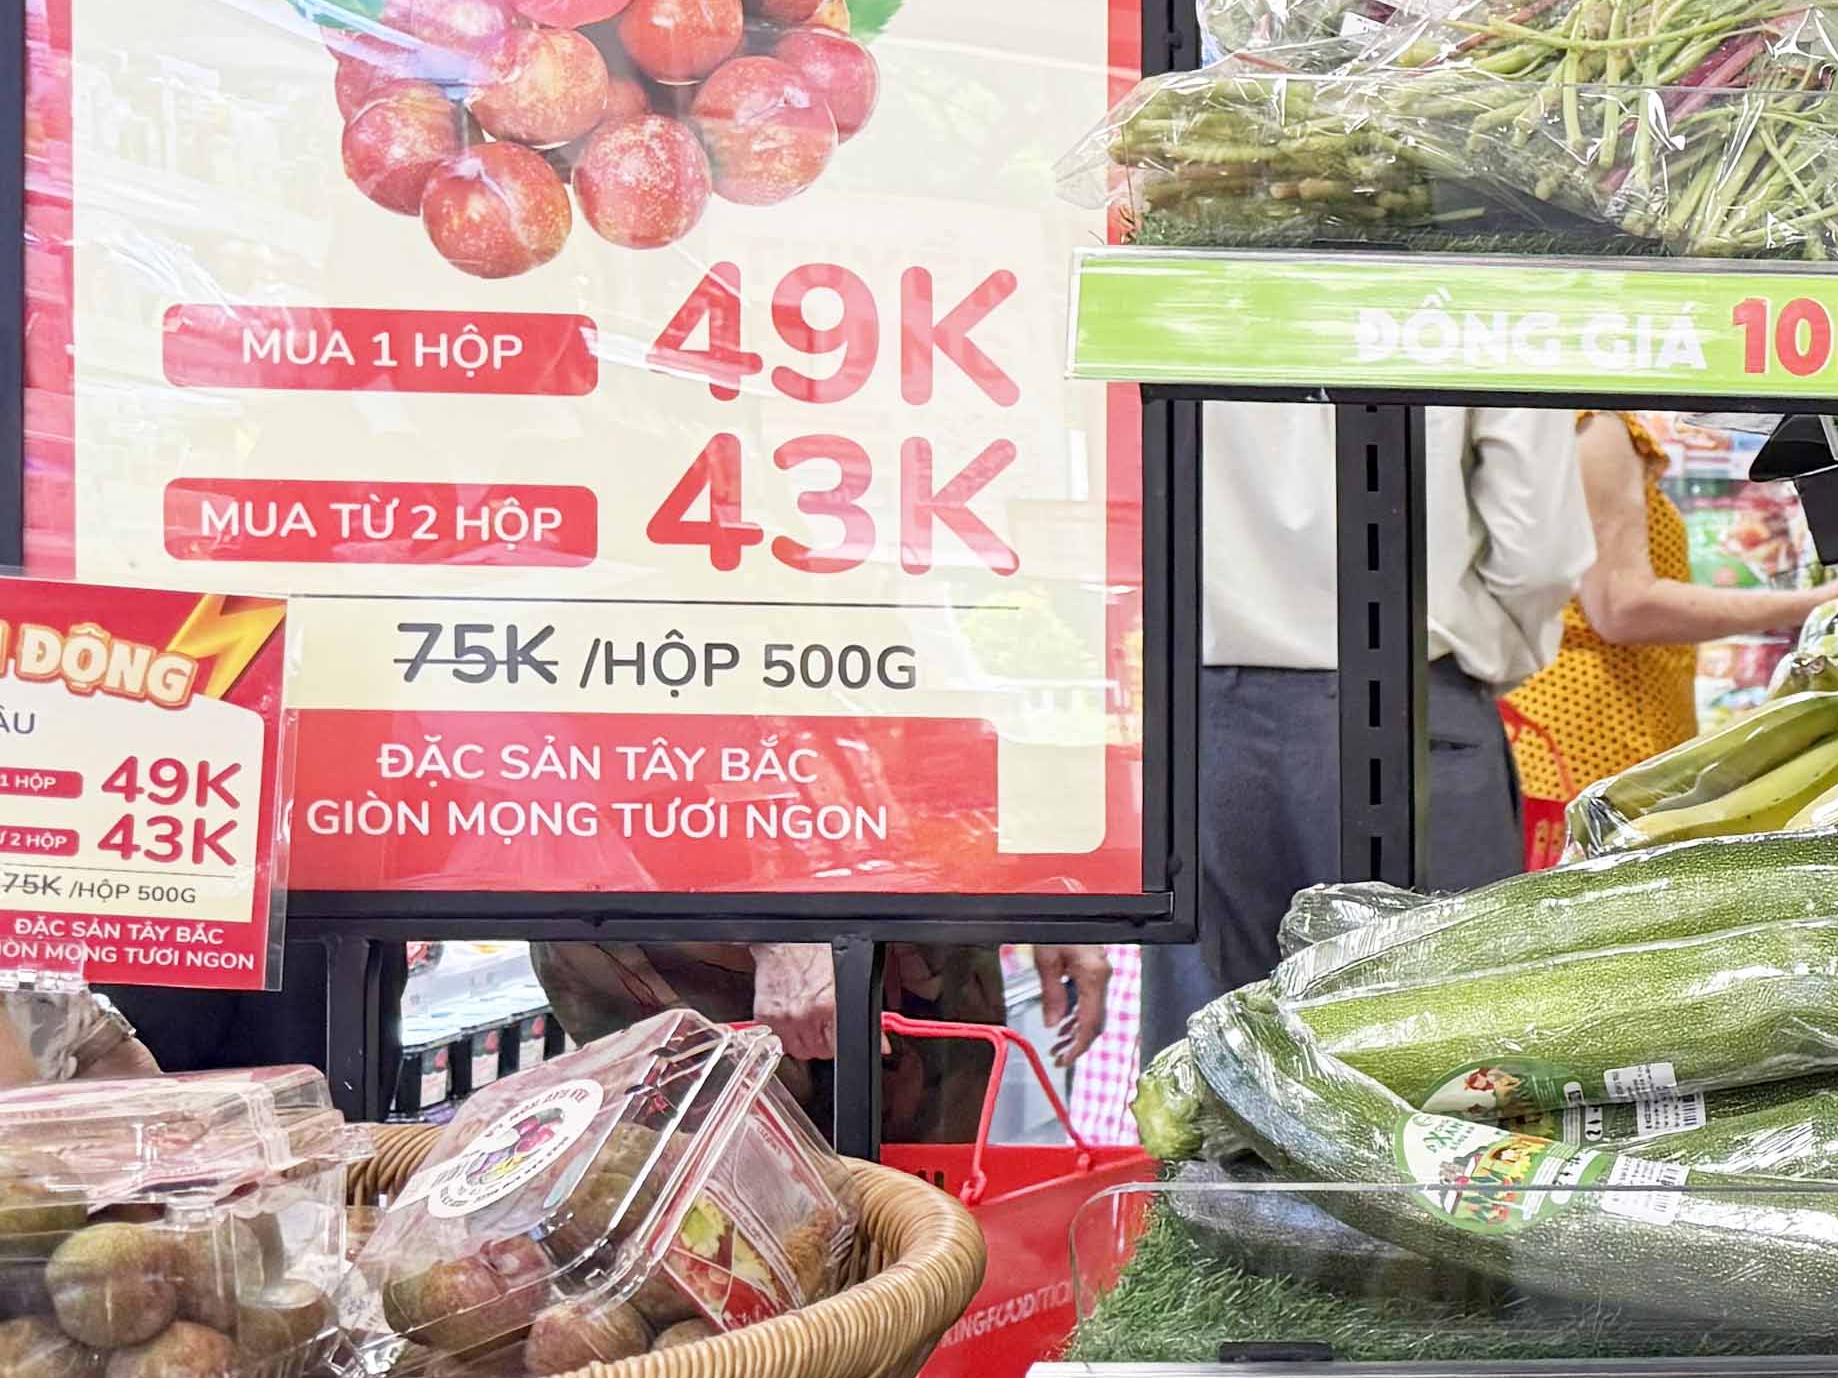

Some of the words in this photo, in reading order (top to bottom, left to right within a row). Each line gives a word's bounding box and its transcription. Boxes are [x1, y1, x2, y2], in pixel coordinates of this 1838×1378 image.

[241, 328, 352, 370] MUA
[373, 329, 393, 370] 1
[415, 323, 524, 376] HỘP
[645, 258, 1021, 408] 49K
[1353, 301, 1560, 375] ĐỒNG
[1574, 301, 1707, 371] GIÁ
[201, 500, 317, 542] MUA
[331, 496, 407, 542] TỪ
[410, 502, 438, 542] 2
[460, 497, 565, 549] HỘP
[645, 431, 1021, 578] 43K
[20, 623, 195, 708] ĐỘNG
[396, 621, 558, 687] 75K
[580, 639, 742, 694] /HỘP
[761, 641, 919, 693] 500G
[14, 774, 57, 794] HỘP
[100, 755, 242, 809] 49K
[374, 731, 462, 788] ĐẶC
[498, 736, 603, 786] SẢN
[614, 733, 713, 785] TÂY
[720, 737, 821, 787] BẮC
[10, 833, 22, 847] 2
[26, 831, 67, 853] HỘP
[97, 813, 238, 867] 43K
[305, 793, 430, 840] GIÒN
[444, 799, 601, 849] MỌNG
[610, 796, 734, 841] TƯƠI
[745, 802, 891, 844] NGON
[2, 871, 61, 897] 75K
[68, 879, 130, 903] /HỘP
[137, 884, 197, 904] 500G
[14, 916, 70, 939] ĐẶC
[75, 920, 121, 941] SẢN
[126, 922, 173, 944] TÂY
[174, 924, 225, 946] BẮC
[44, 943, 118, 966] MỌNG
[122, 946, 180, 967] TƯƠI
[185, 951, 255, 970] NGON
